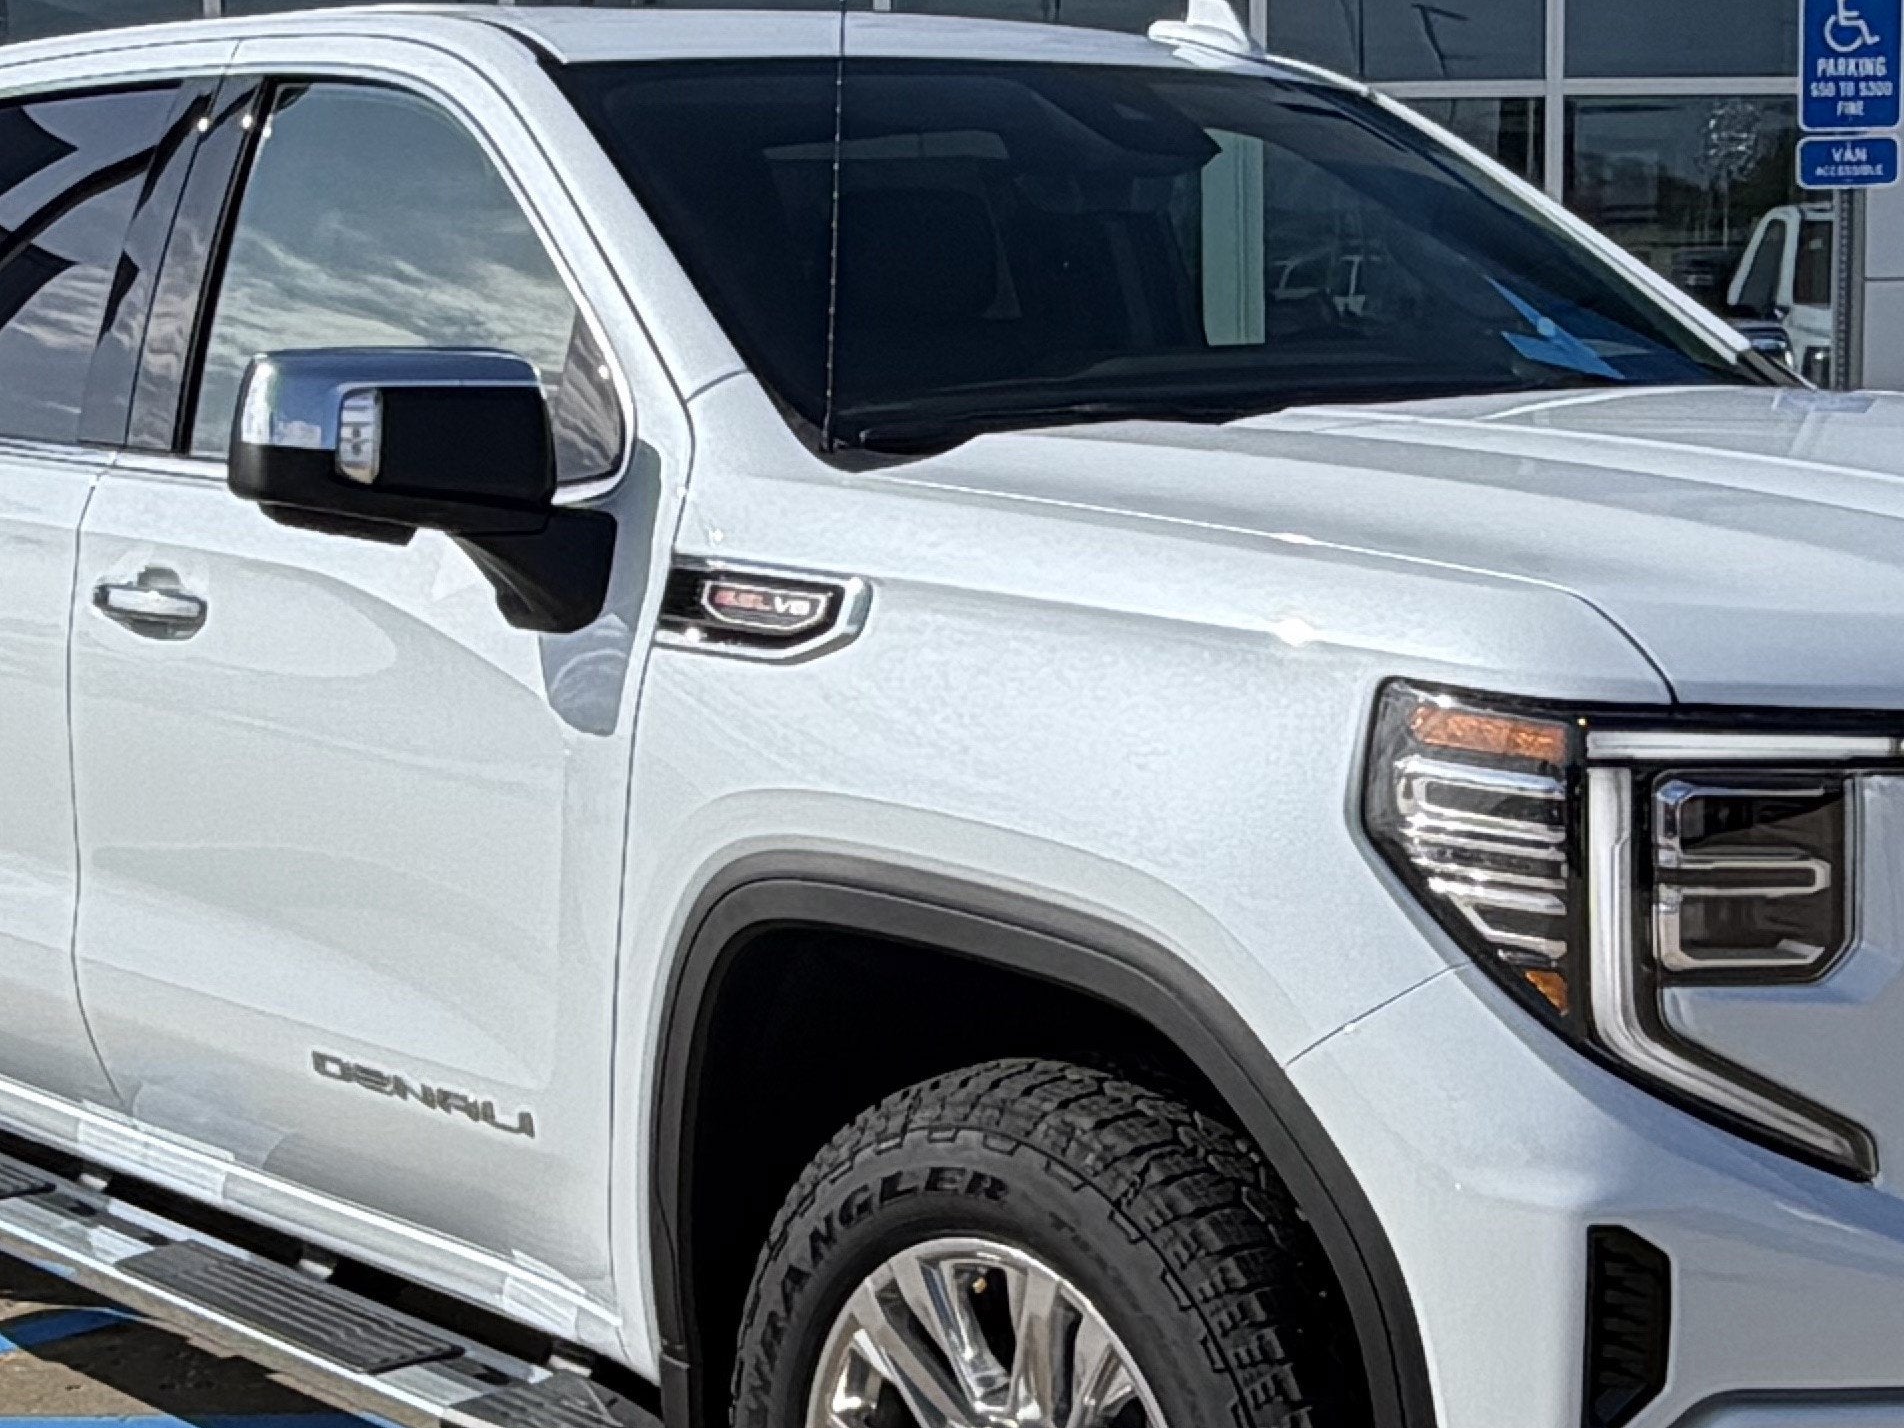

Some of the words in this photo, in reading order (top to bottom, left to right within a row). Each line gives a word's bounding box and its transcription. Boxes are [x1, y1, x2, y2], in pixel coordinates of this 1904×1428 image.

[1816, 56, 1888, 77] PARKING
[1838, 80, 1856, 98] TO
[1836, 100, 1865, 116] FINE
[1831, 145, 1868, 162] VAN
[310, 1049, 536, 1140] DENALI
